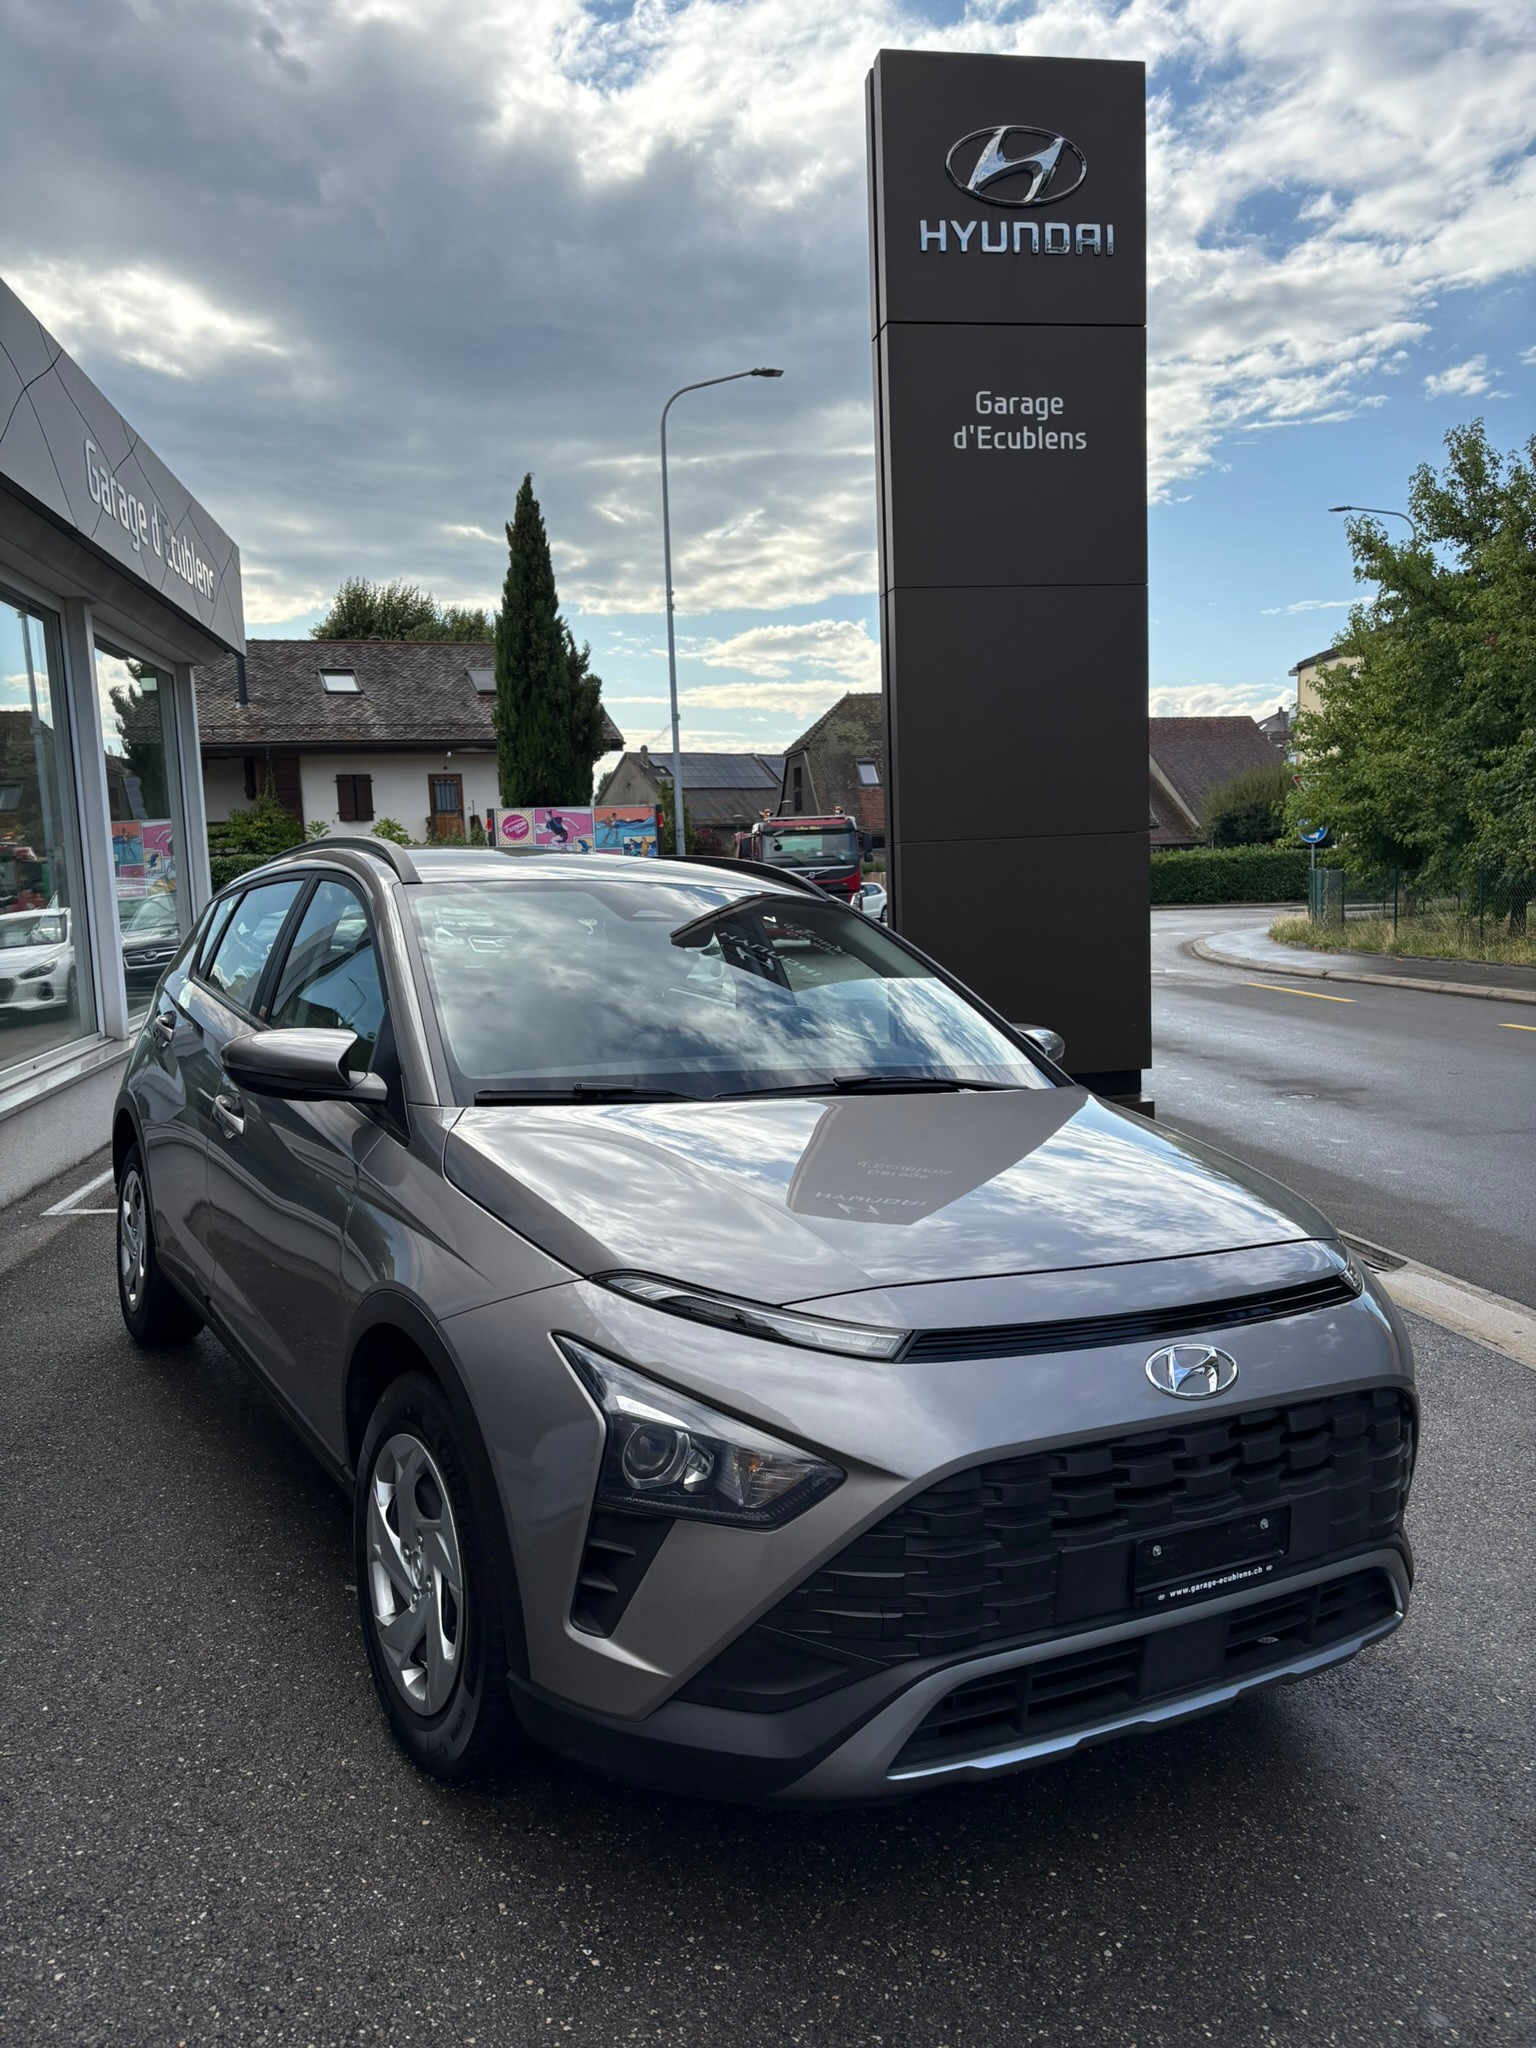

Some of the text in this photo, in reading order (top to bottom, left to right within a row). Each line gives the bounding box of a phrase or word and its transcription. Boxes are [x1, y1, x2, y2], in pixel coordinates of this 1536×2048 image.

[919, 219, 1114, 256] HYUNDAI
[975, 390, 1065, 421] Garage
[953, 425, 1088, 450] d'Ecublens
[84, 438, 148, 552] Garage
[1169, 1565, 1263, 1598] www.garage-ecublens.ch
